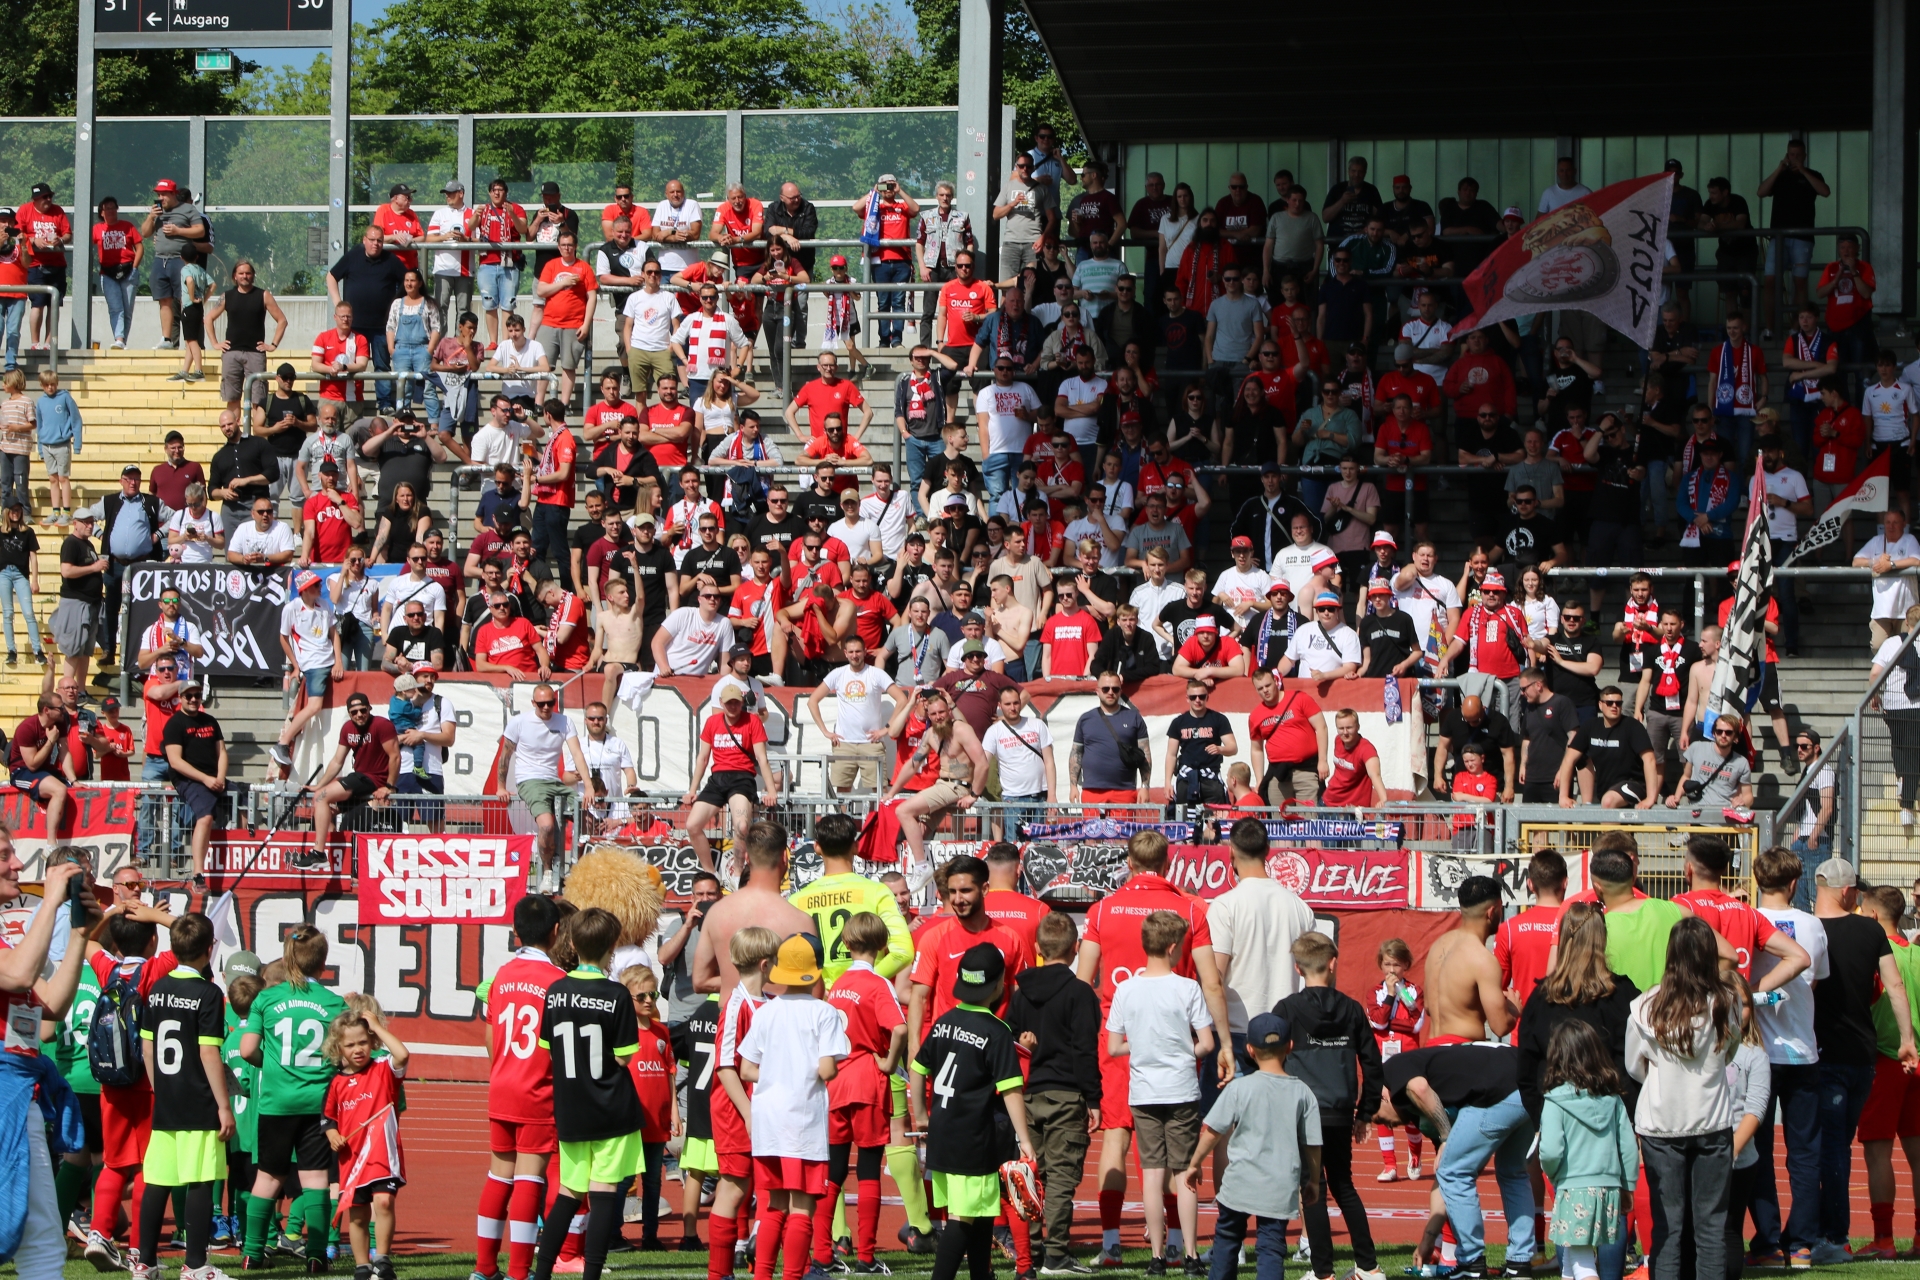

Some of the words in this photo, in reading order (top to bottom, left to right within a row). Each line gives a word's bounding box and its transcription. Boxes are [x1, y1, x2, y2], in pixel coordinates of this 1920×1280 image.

[173, 14, 229, 28] Ausgang
[881, 214, 901, 222] OKAL
[951, 299, 973, 307] OKAL
[995, 392, 1021, 400] KASSEL
[1286, 556, 1298, 564] RED
[131, 569, 212, 603] CHAOS
[195, 624, 270, 670] ssel
[1030, 821, 1086, 841] ULTRA
[1297, 820, 1366, 839] CONNECTION
[204, 847, 281, 871] ALIANCO
[367, 838, 520, 879] KASSEL
[1310, 856, 1406, 898] LENCE
[379, 878, 507, 918] SQUAD
[807, 891, 852, 910] GRÖTEKE
[1005, 911, 1028, 920] KASSEL
[1110, 906, 1124, 915] KSV
[1125, 906, 1153, 917] HESSEN
[1518, 923, 1532, 932] KSV
[231, 963, 258, 976] adidas
[961, 971, 983, 984] CHILL
[499, 981, 516, 995] SVH
[836, 987, 861, 1005] KASSEL
[148, 992, 163, 1007] SVH
[166, 993, 202, 1011] Kassel
[273, 1003, 287, 1015] TSV
[288, 999, 328, 1018] Altmorschen
[547, 992, 567, 1010] SVH
[570, 992, 617, 1014] Kassel
[497, 1002, 540, 1060] 13
[932, 1023, 953, 1040] SVH
[952, 1026, 989, 1050] Kassel
[156, 1019, 184, 1076] 6
[274, 1017, 326, 1067] 12
[552, 1021, 603, 1081] 11
[637, 1060, 665, 1072] OKAL
[694, 1041, 718, 1091] 7
[933, 1051, 958, 1109] 4
